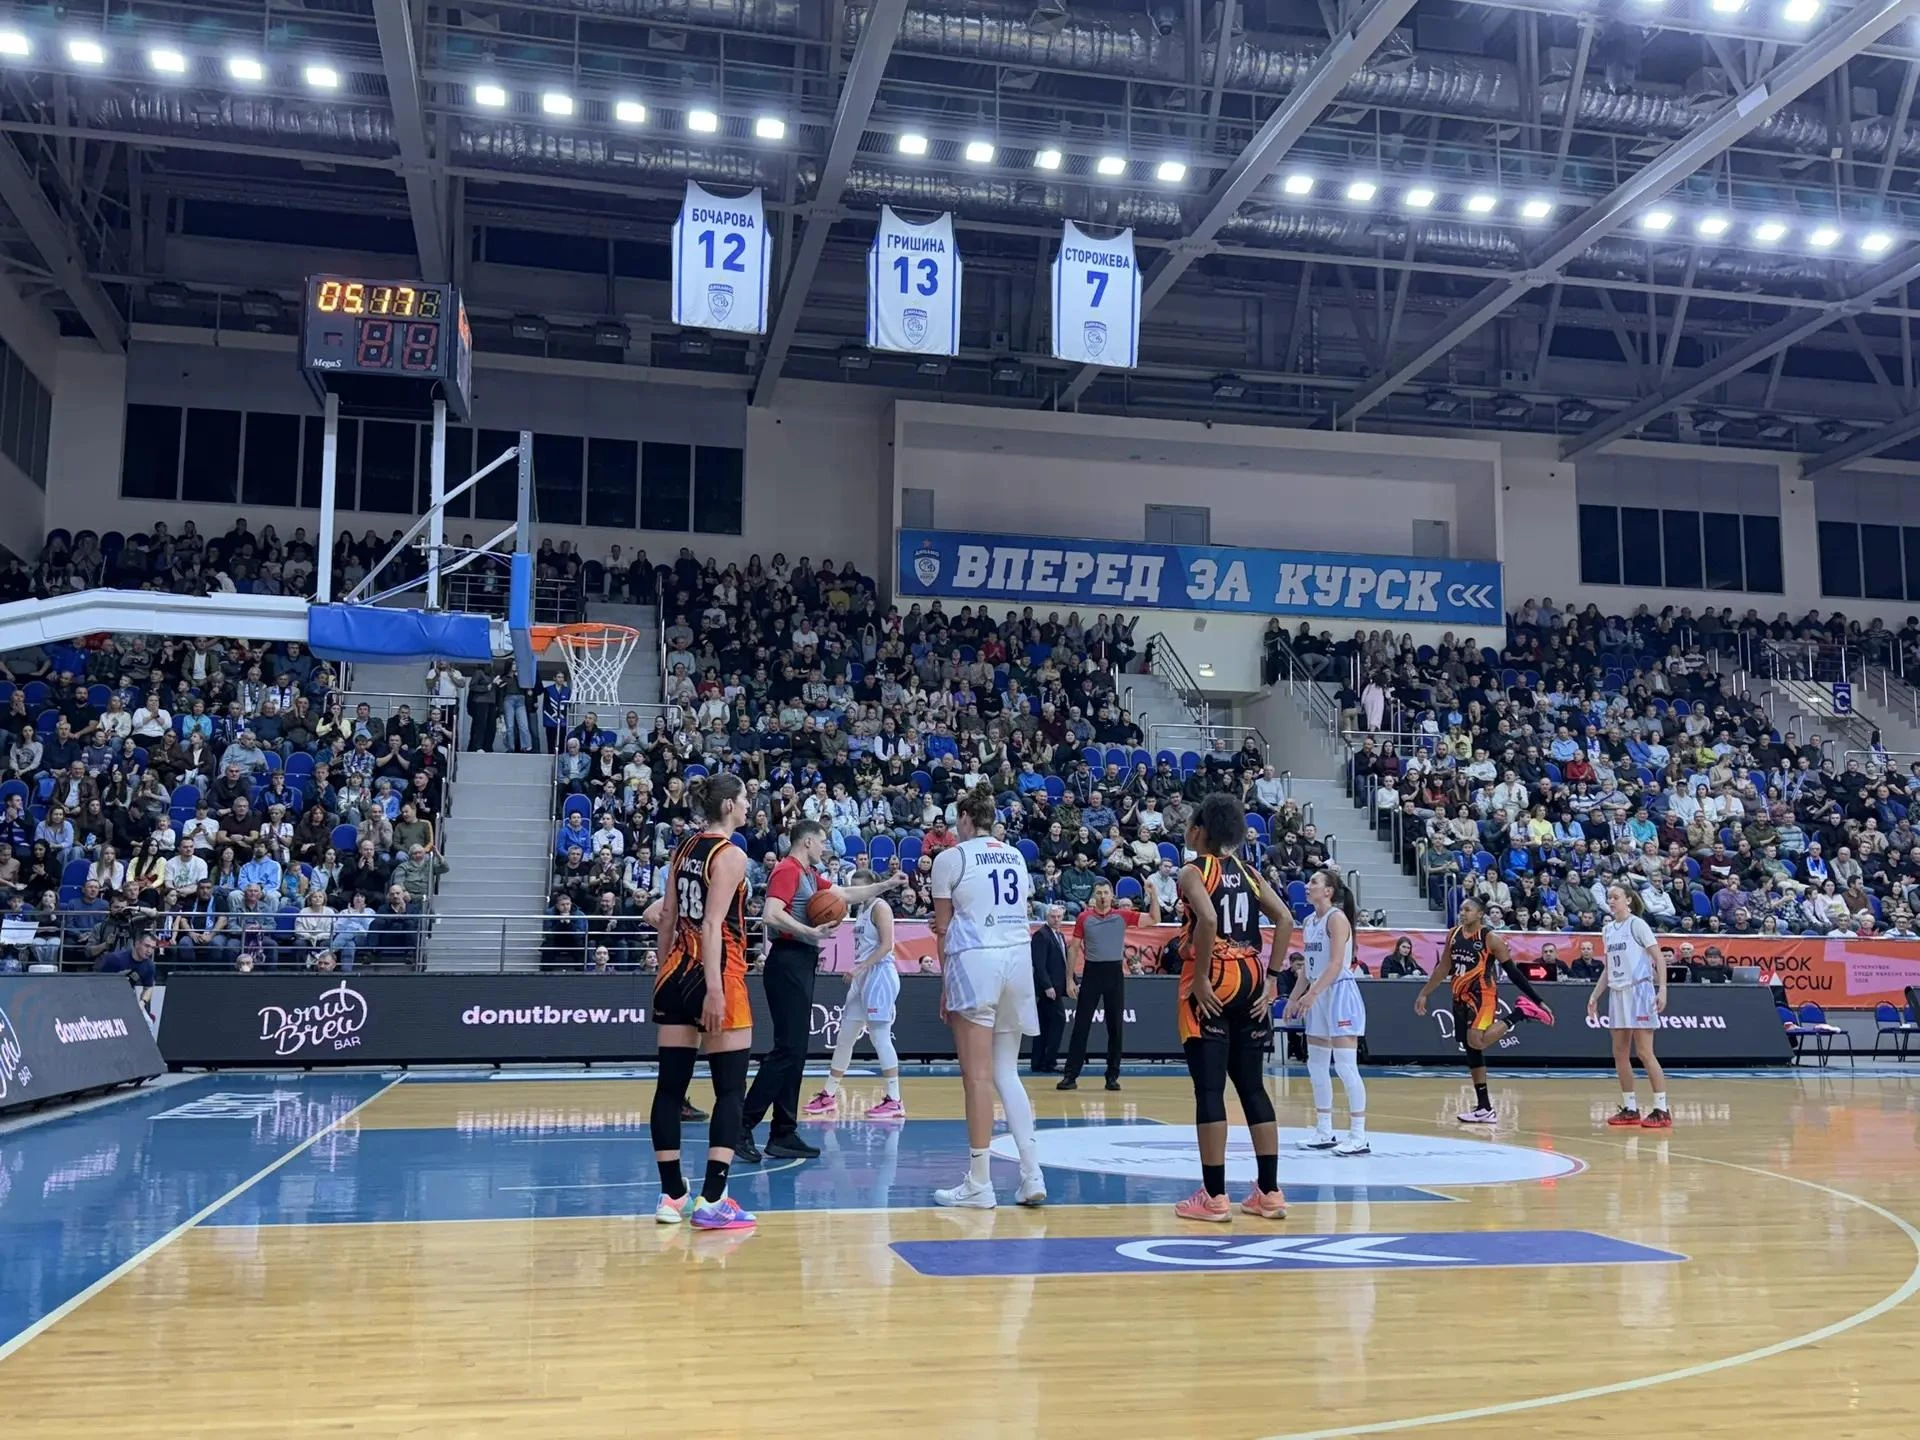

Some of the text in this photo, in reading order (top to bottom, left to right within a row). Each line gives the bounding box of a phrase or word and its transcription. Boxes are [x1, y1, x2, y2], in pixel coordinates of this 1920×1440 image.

[692, 208, 754, 229] БОЧАРОВА
[698, 230, 746, 272] 12
[887, 234, 945, 253] ГРИШИНА
[1065, 247, 1130, 269] СТОРОЖЕВА
[893, 256, 939, 296] 13
[1087, 270, 1109, 307] 7
[313, 358, 342, 368] MegaS
[952, 544, 1165, 602] ВПЕРЕД
[1186, 559, 1251, 602] ЗА
[1275, 563, 1442, 612] КУРСК
[678, 877, 704, 919] 38
[988, 868, 1019, 905] 13
[1220, 892, 1249, 934] 14
[1454, 963, 1467, 977] 20
[258, 980, 362, 1041] Donut
[462, 1005, 645, 1024] donutbrew.ru
[1585, 1014, 1727, 1029] dorew.ru
[55, 1016, 128, 1044] donutbrew.ru
[274, 1014, 366, 1055] Brew
[334, 1036, 362, 1051] BAR
[1499, 1035, 1521, 1048] BAR
